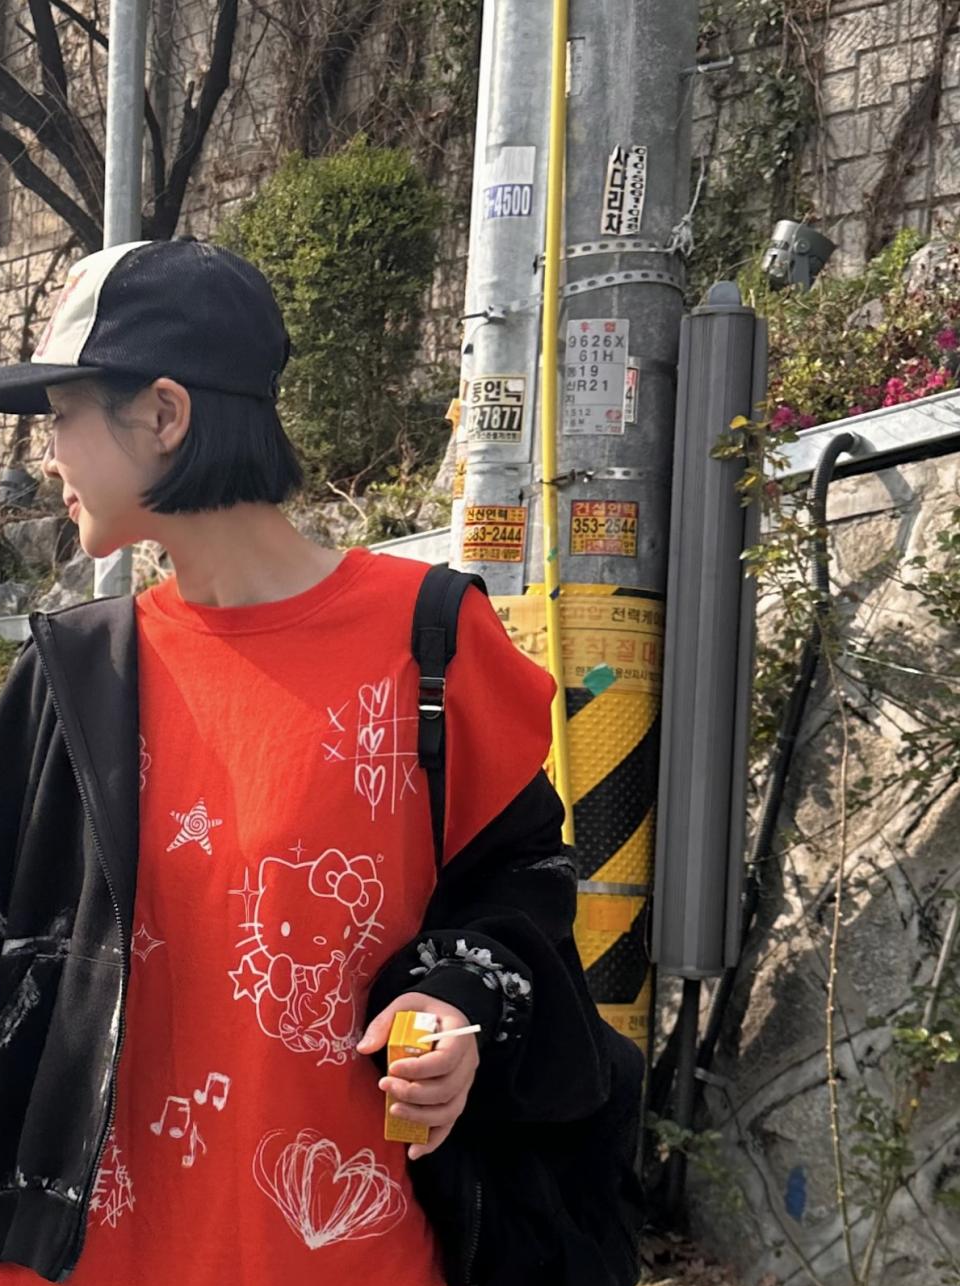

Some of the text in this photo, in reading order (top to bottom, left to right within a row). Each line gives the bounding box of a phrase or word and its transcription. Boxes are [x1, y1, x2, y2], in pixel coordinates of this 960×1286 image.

[603, 146, 630, 235] 사다리차
[568, 334, 625, 348] 9626X
[579, 349, 614, 362] 61H
[573, 517, 636, 535] 353-2544
